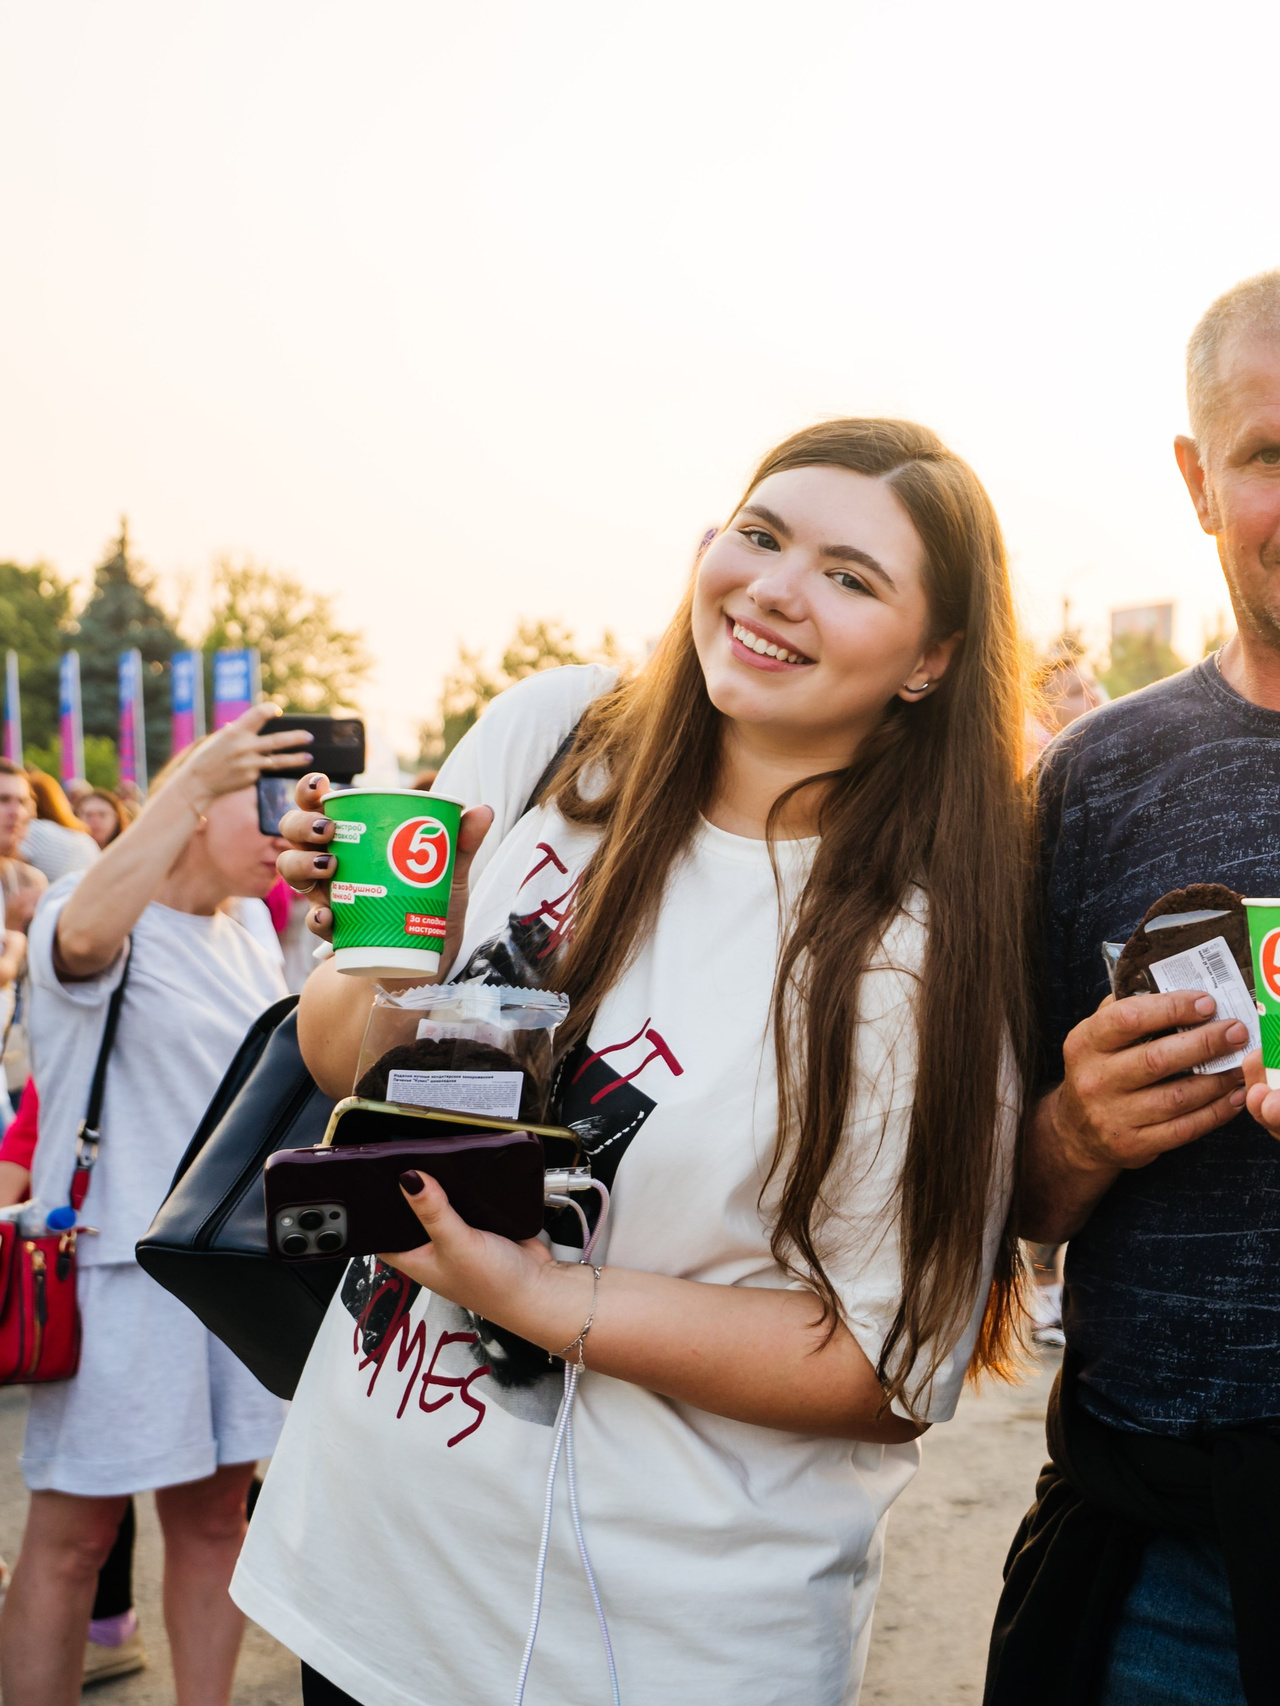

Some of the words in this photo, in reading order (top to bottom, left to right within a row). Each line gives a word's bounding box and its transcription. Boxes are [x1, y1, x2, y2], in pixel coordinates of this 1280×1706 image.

[406, 822, 441, 875] 5
[338, 884, 383, 894] воздушной
[410, 914, 421, 923] За
